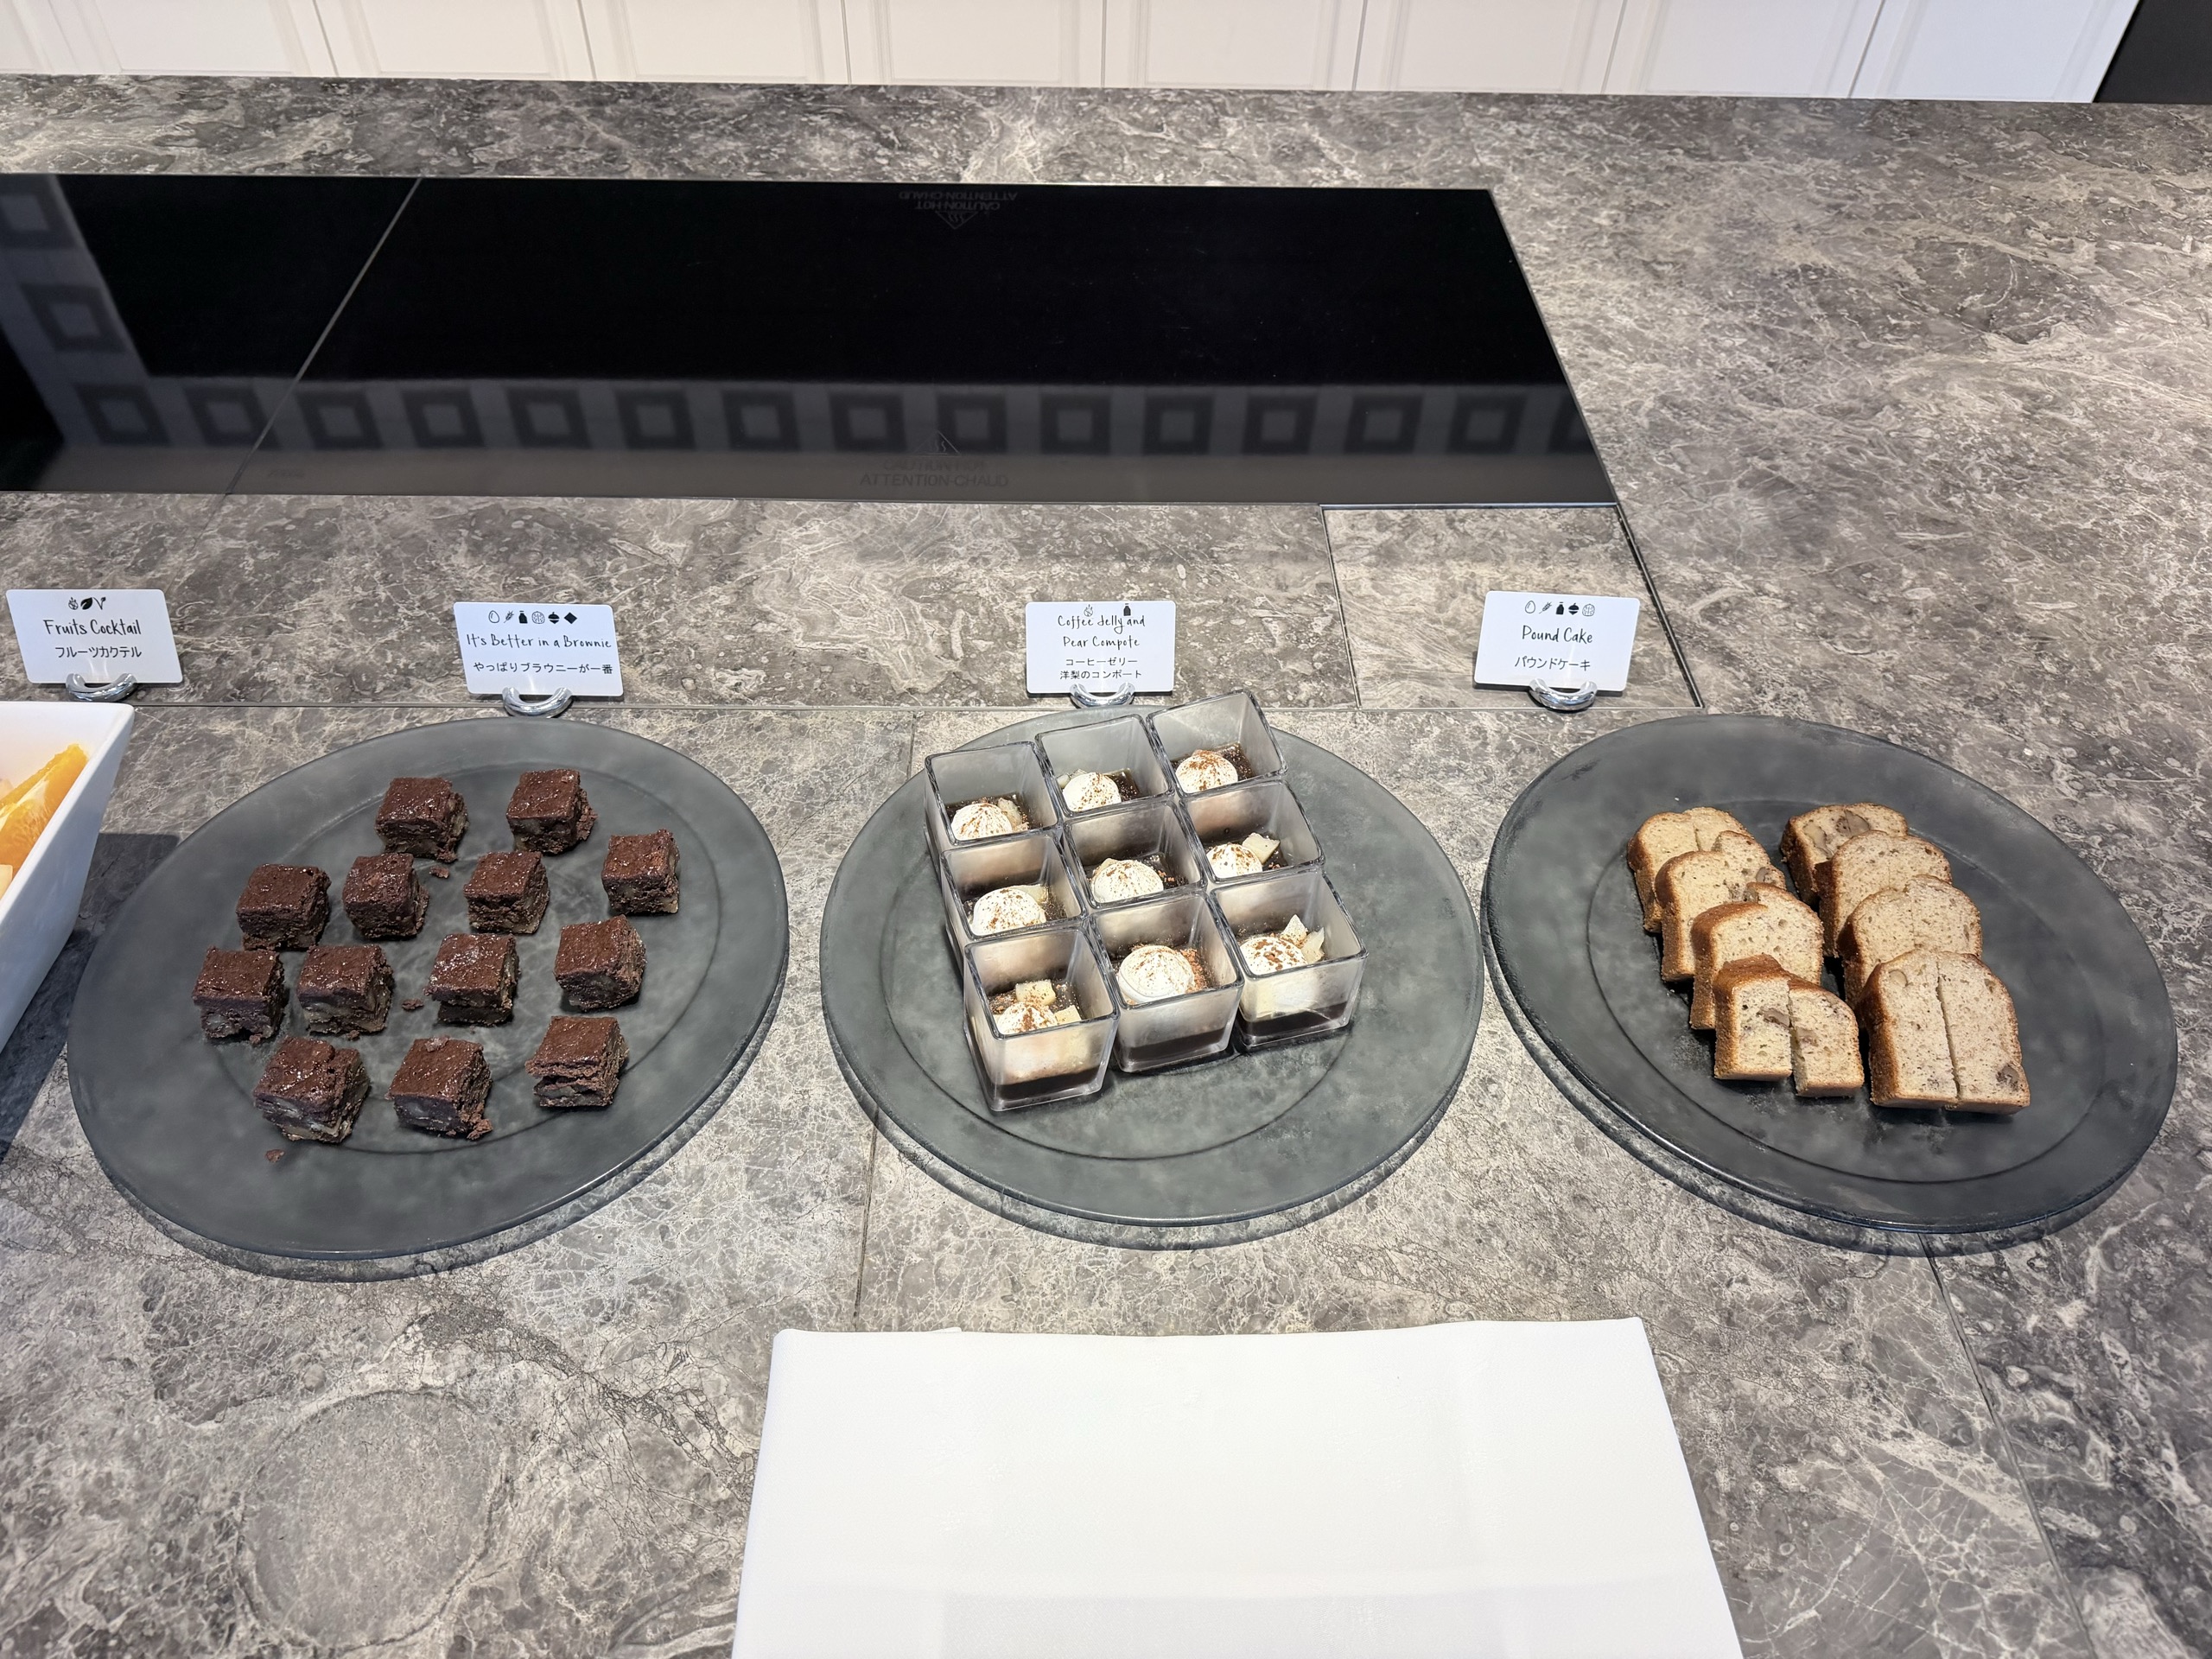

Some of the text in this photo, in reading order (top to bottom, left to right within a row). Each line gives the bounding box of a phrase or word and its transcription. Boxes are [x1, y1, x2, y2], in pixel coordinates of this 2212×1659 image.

[43, 619, 142, 636] Fruits Cocktail
[1058, 614, 1146, 635] Coffee Jelly and
[467, 633, 612, 649] It's Better in a Brownie
[1522, 625, 1593, 644] Pound Cake
[1063, 635, 1141, 651] Pear Compote
[54, 646, 143, 658] フルーツカクテル
[473, 661, 613, 675] やっぱりブラウニーが一番
[1065, 657, 1138, 667] コーヒーゼリー
[1515, 655, 1592, 671] パウンドケーキ
[1059, 670, 1142, 680] 洋梨のコンポート
